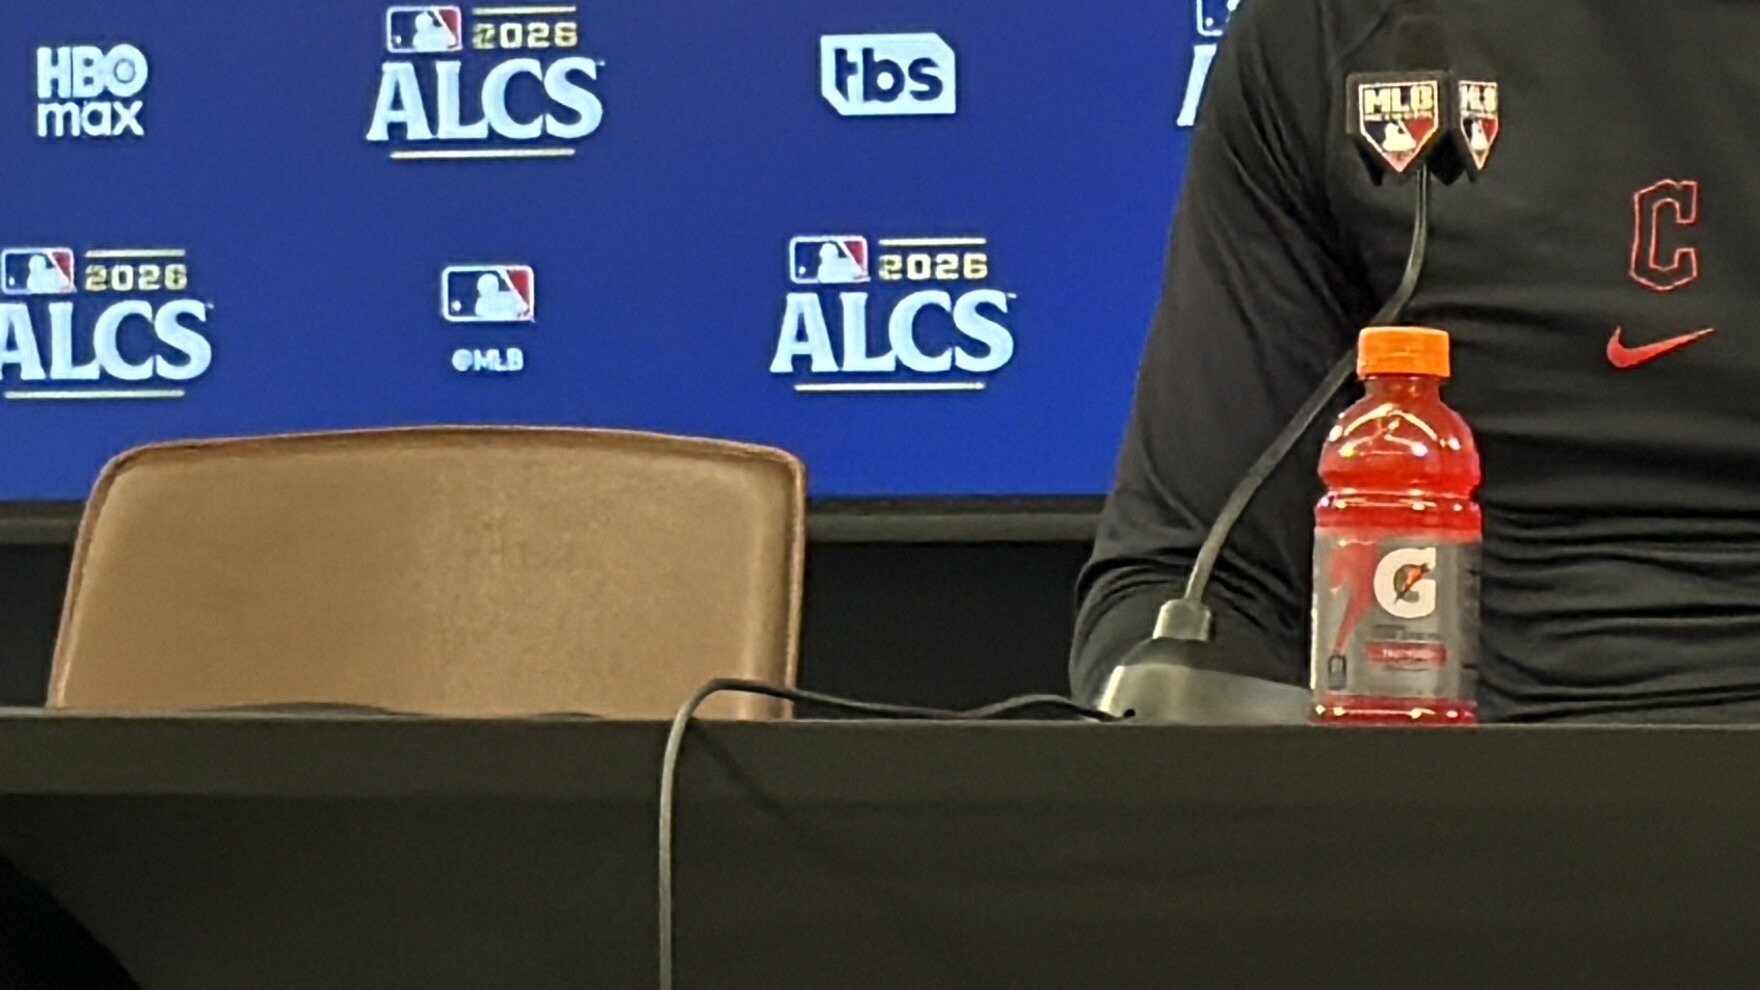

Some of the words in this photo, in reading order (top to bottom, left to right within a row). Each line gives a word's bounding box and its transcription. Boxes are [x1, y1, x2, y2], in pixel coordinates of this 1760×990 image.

[472, 22, 577, 50] 2026
[37, 43, 148, 100] HBO
[833, 48, 943, 103] tbs
[37, 99, 144, 138] max
[366, 57, 604, 141] ALCS
[1364, 85, 1433, 114] MLB
[1629, 178, 1698, 292] C
[85, 265, 187, 290] 2026
[879, 253, 988, 281] 2026
[769, 290, 1014, 374] ALCS
[452, 348, 524, 373] @MLB
[1373, 547, 1437, 618] G
